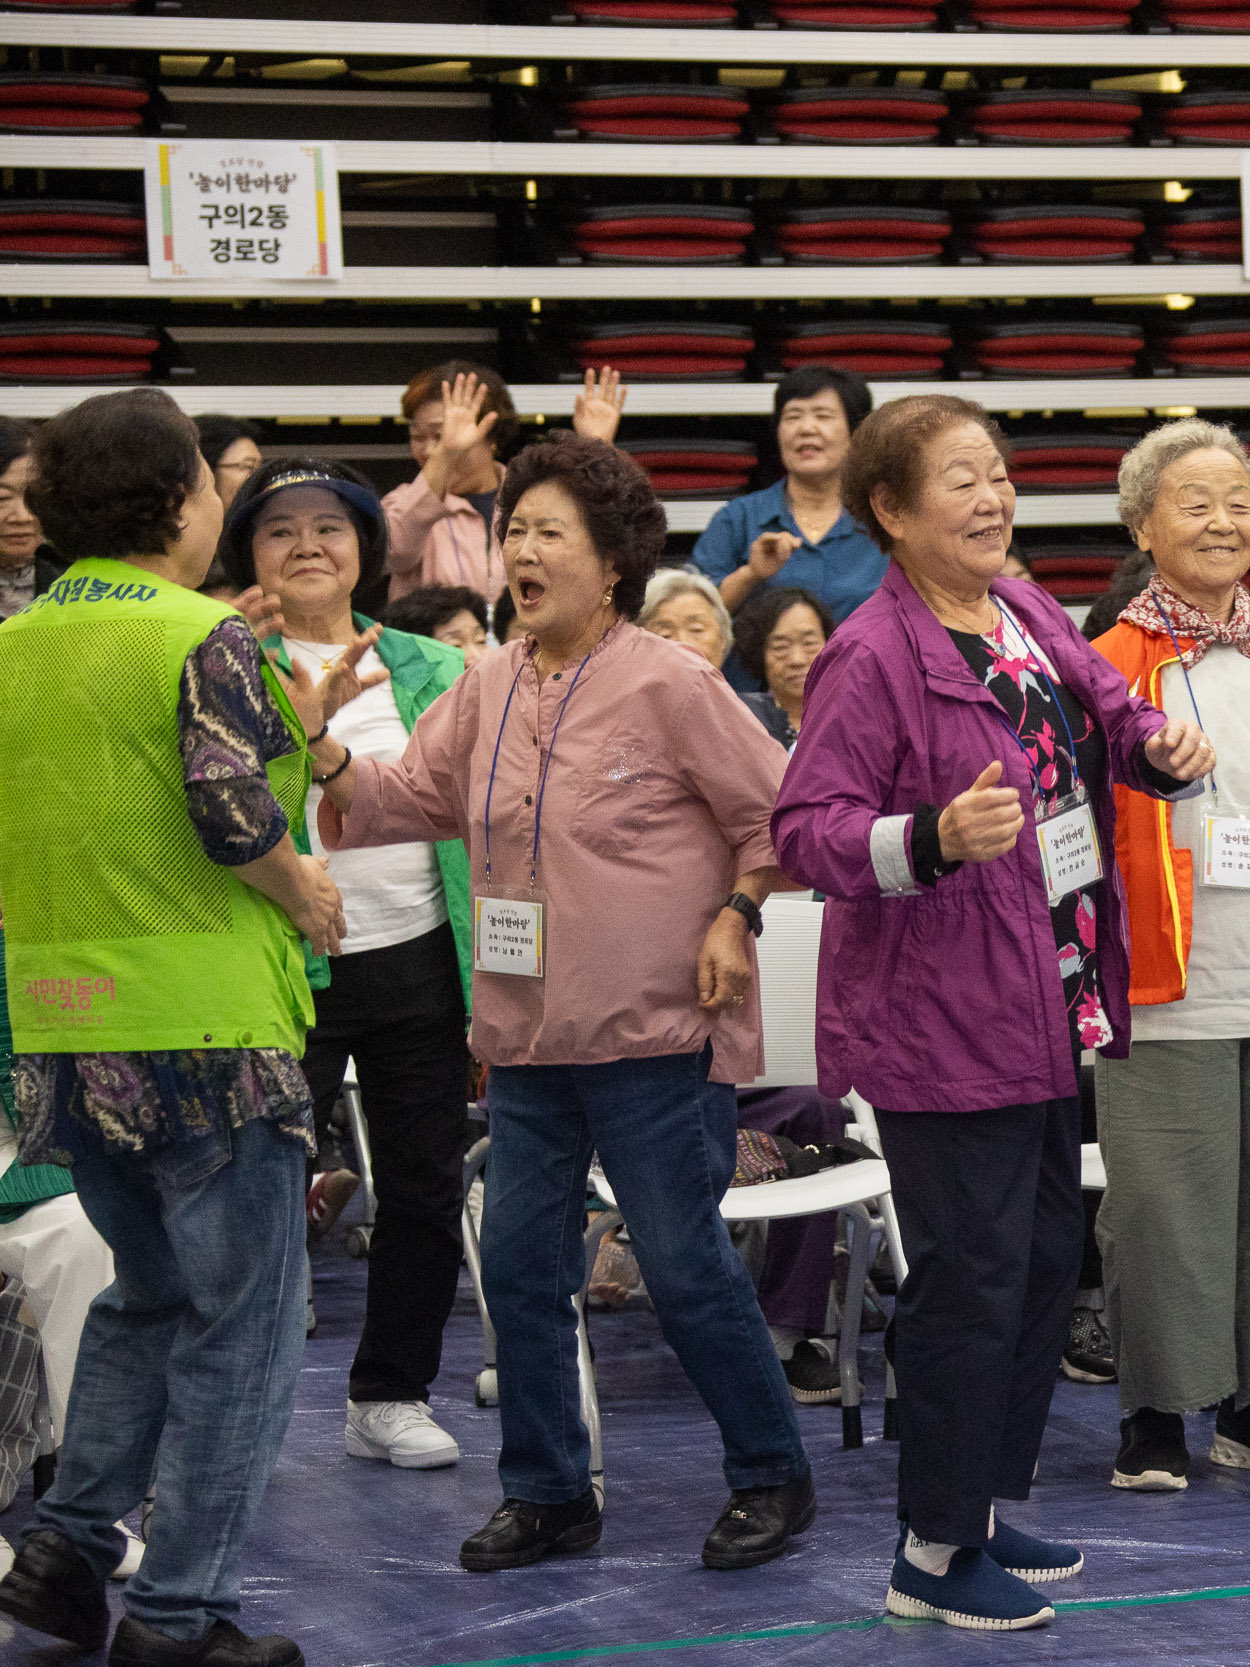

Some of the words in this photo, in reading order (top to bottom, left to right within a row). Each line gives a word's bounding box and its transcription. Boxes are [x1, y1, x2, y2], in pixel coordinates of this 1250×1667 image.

[198, 203, 290, 230] 구의2동
[209, 237, 282, 265] 경로당
[25, 975, 116, 1012] 시민찾동이
